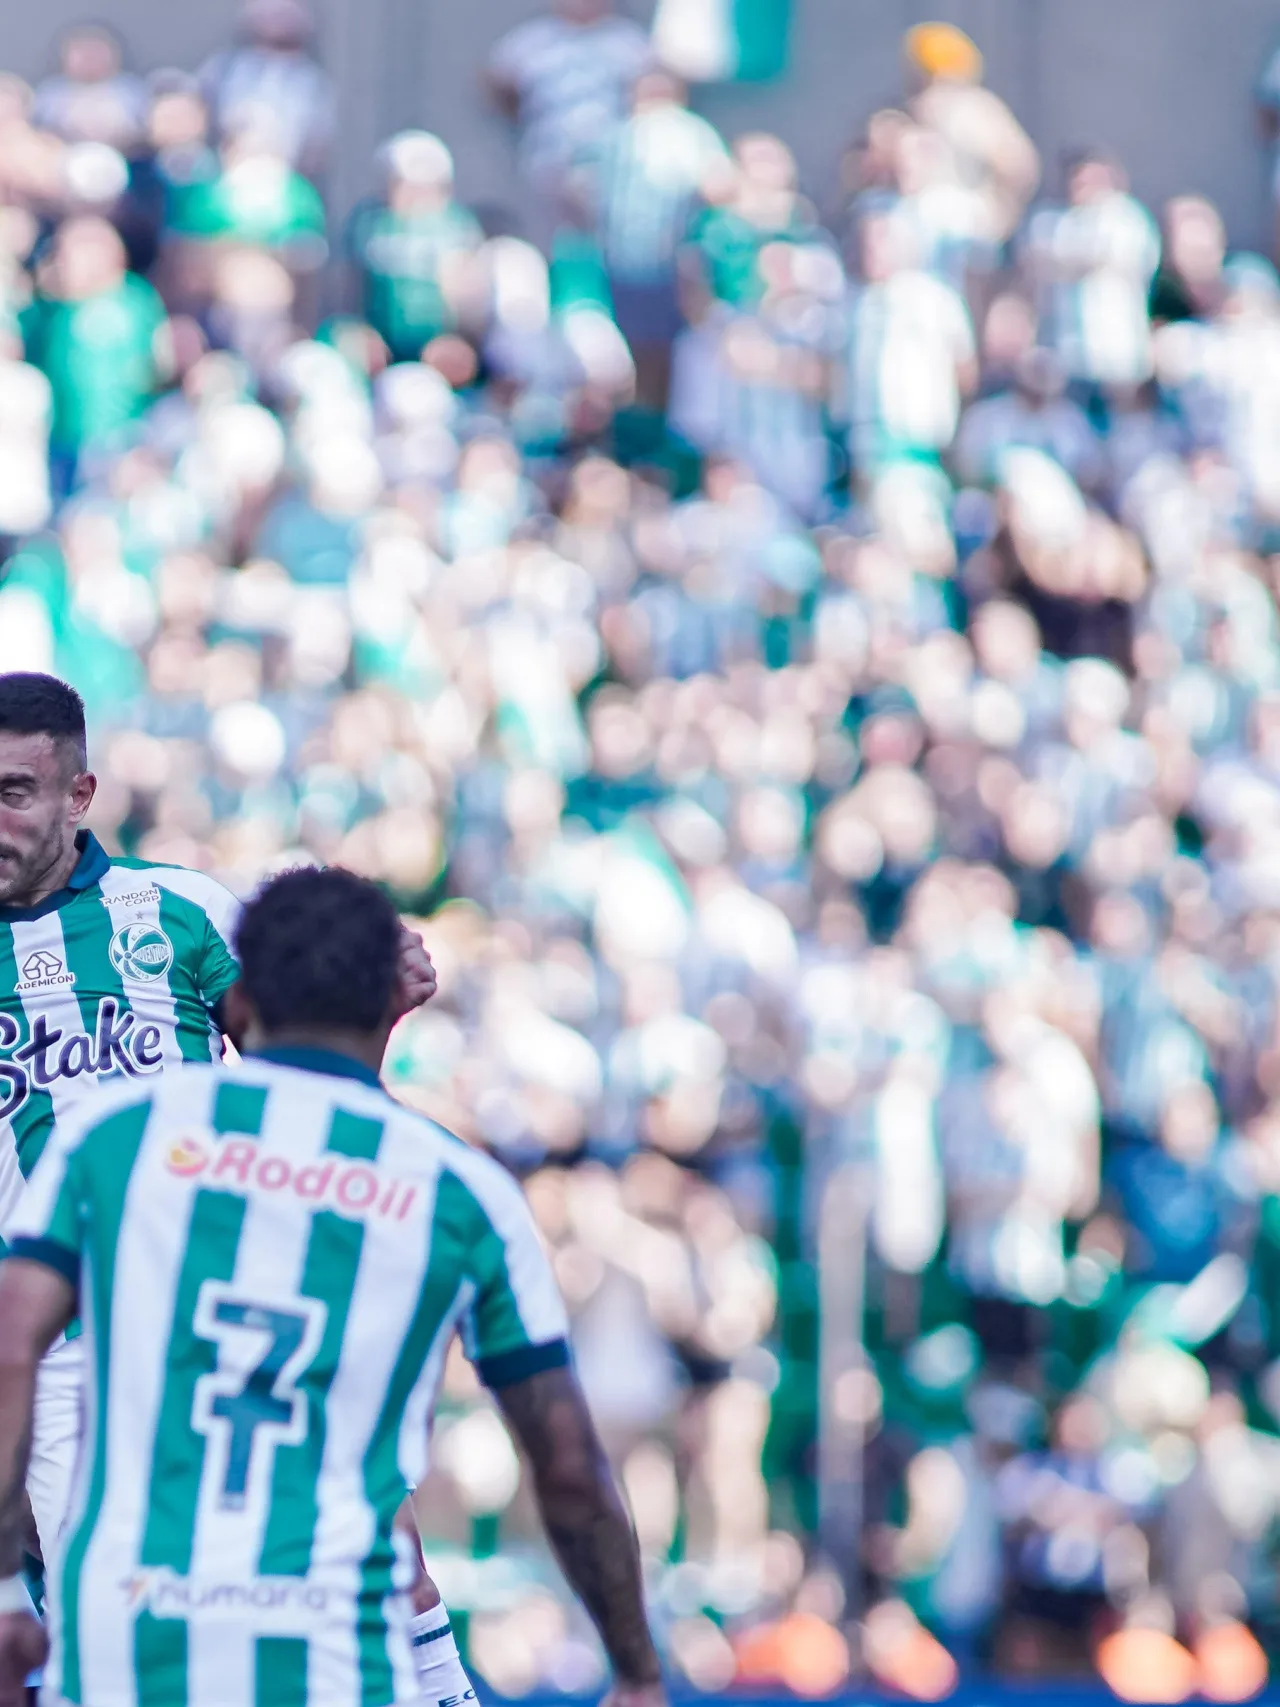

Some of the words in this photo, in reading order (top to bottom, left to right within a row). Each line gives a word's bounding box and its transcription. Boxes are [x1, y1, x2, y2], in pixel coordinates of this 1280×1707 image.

[104, 888, 158, 905] RANDON
[125, 895, 159, 907] CORP
[15, 974, 74, 991] ADEMICON
[213, 1140, 417, 1222] RodOil
[203, 1288, 319, 1513] 7
